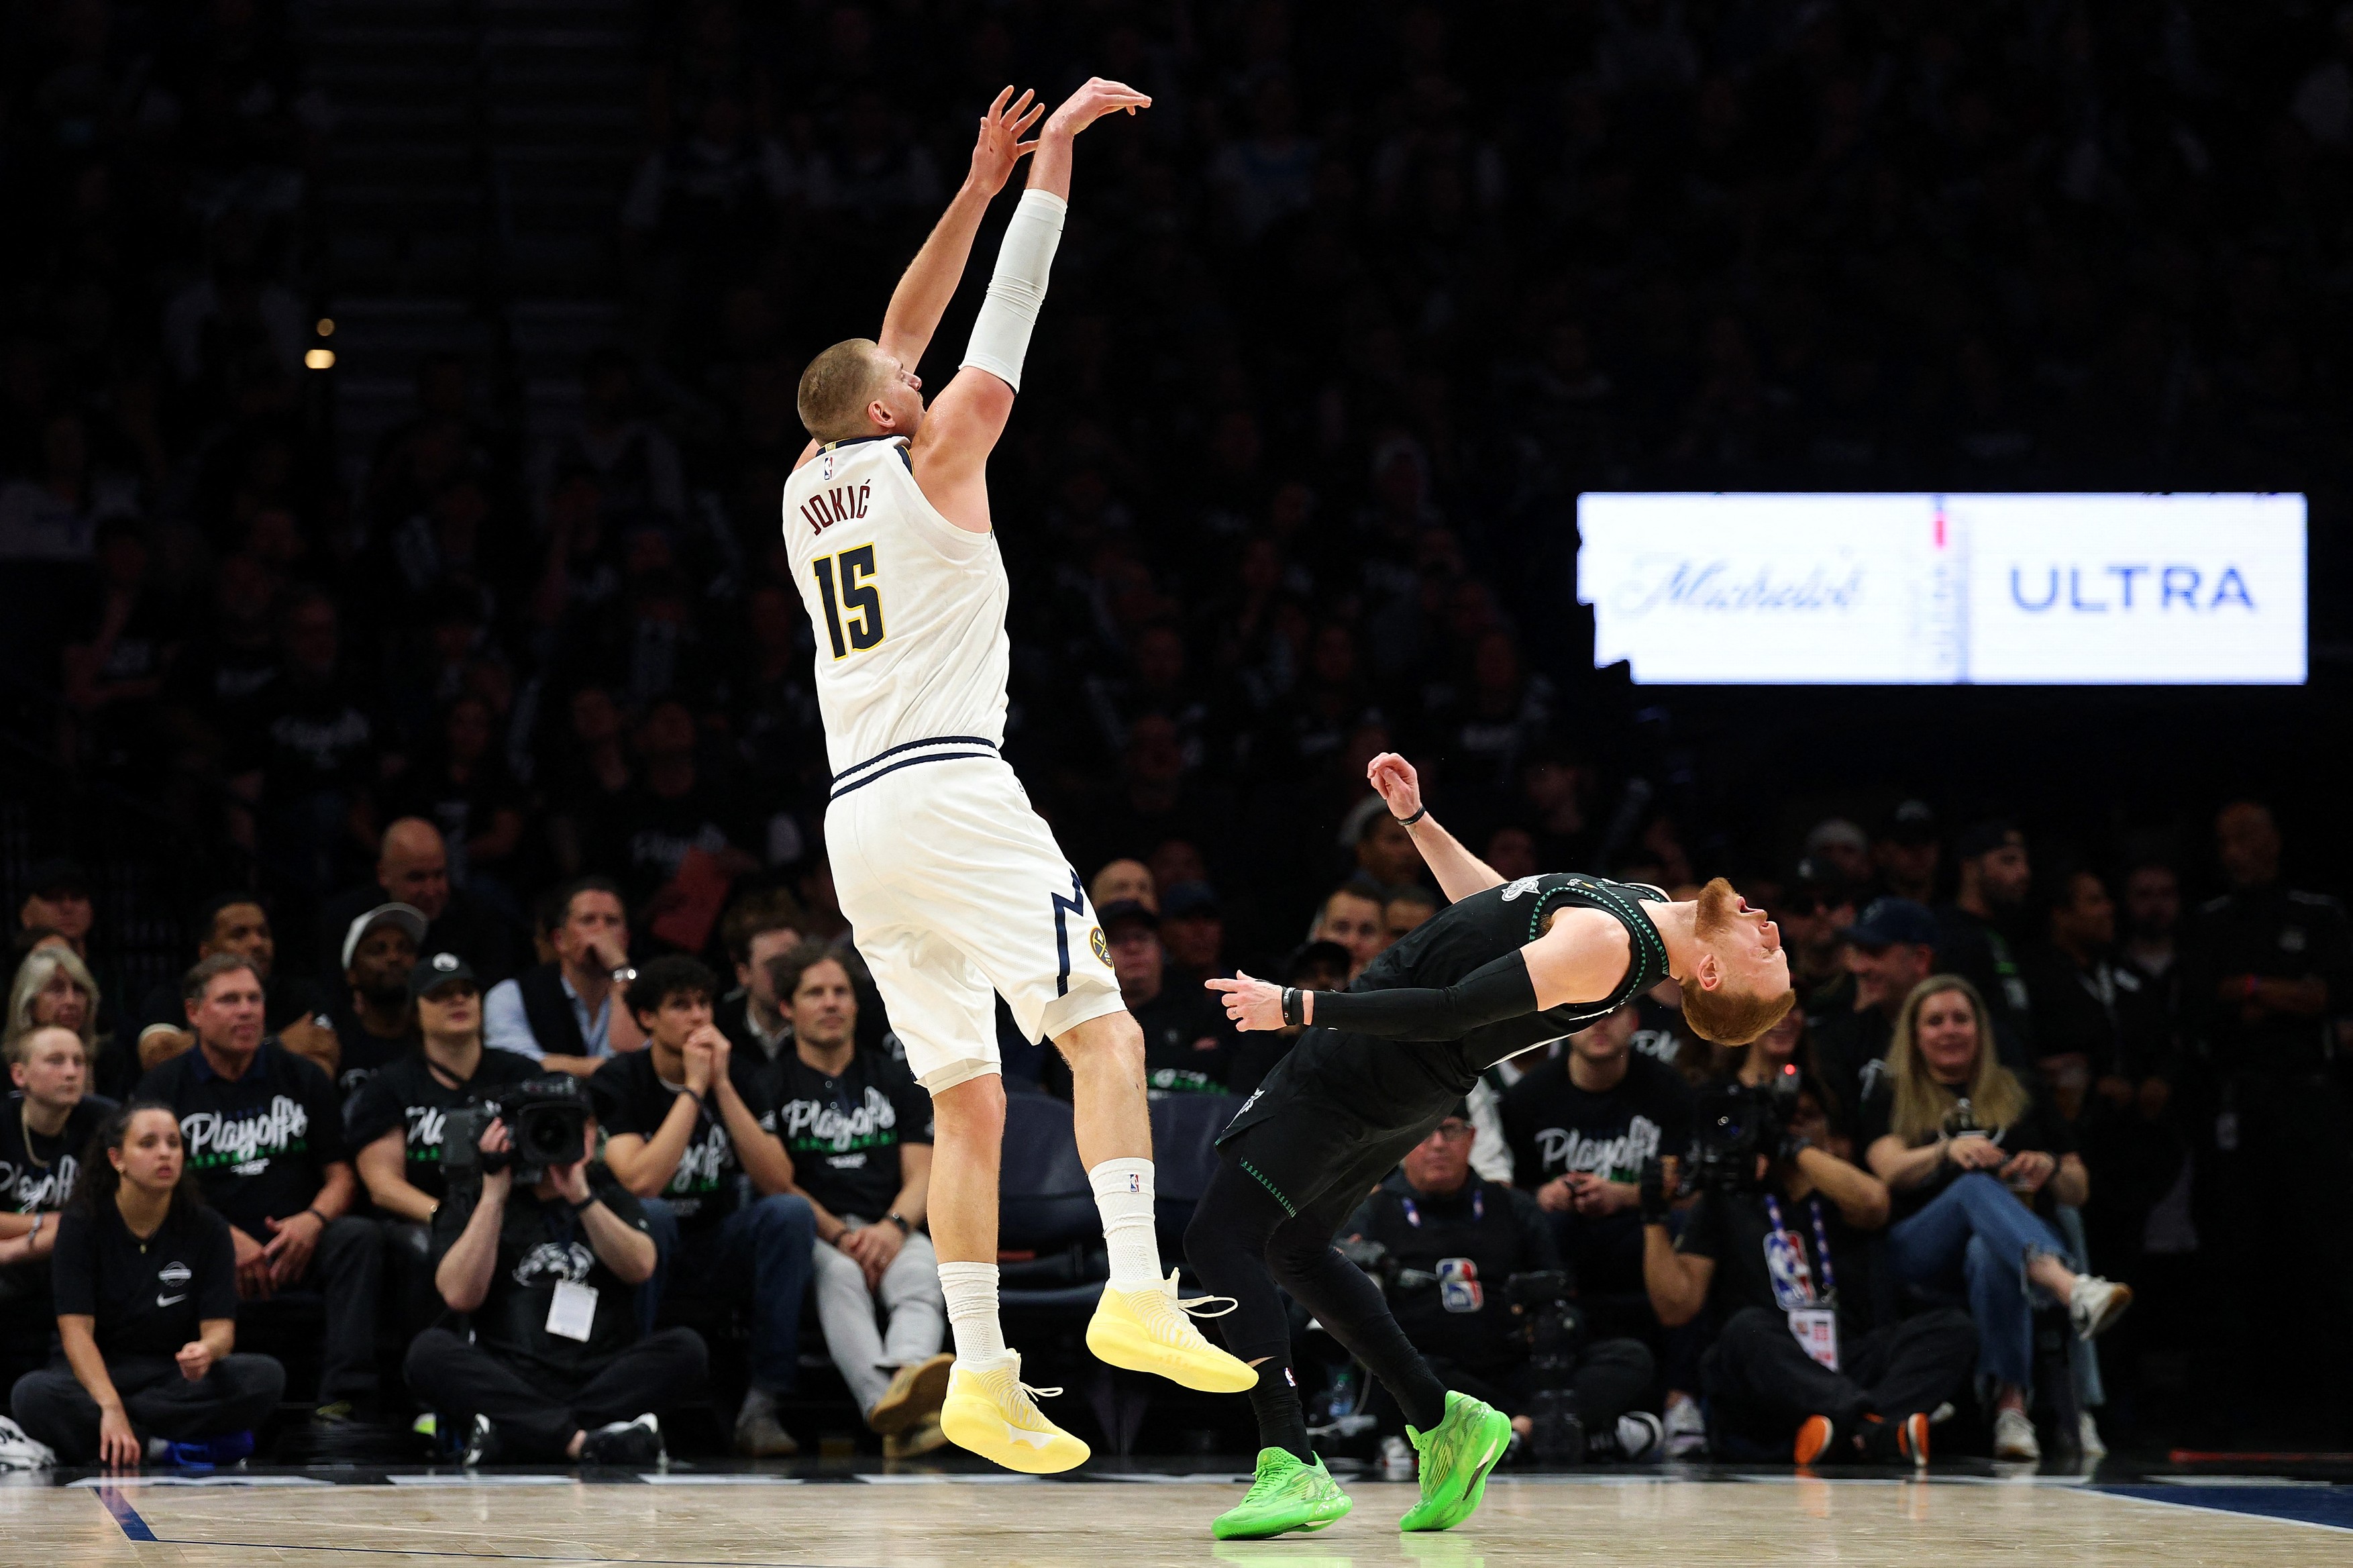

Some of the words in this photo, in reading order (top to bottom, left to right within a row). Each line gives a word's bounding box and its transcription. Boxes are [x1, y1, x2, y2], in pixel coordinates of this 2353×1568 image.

[800, 479, 871, 536] JOKIĆ
[811, 541, 887, 662] 15
[2009, 564, 2256, 613] ULTRA
[180, 1094, 309, 1162] Playoffs
